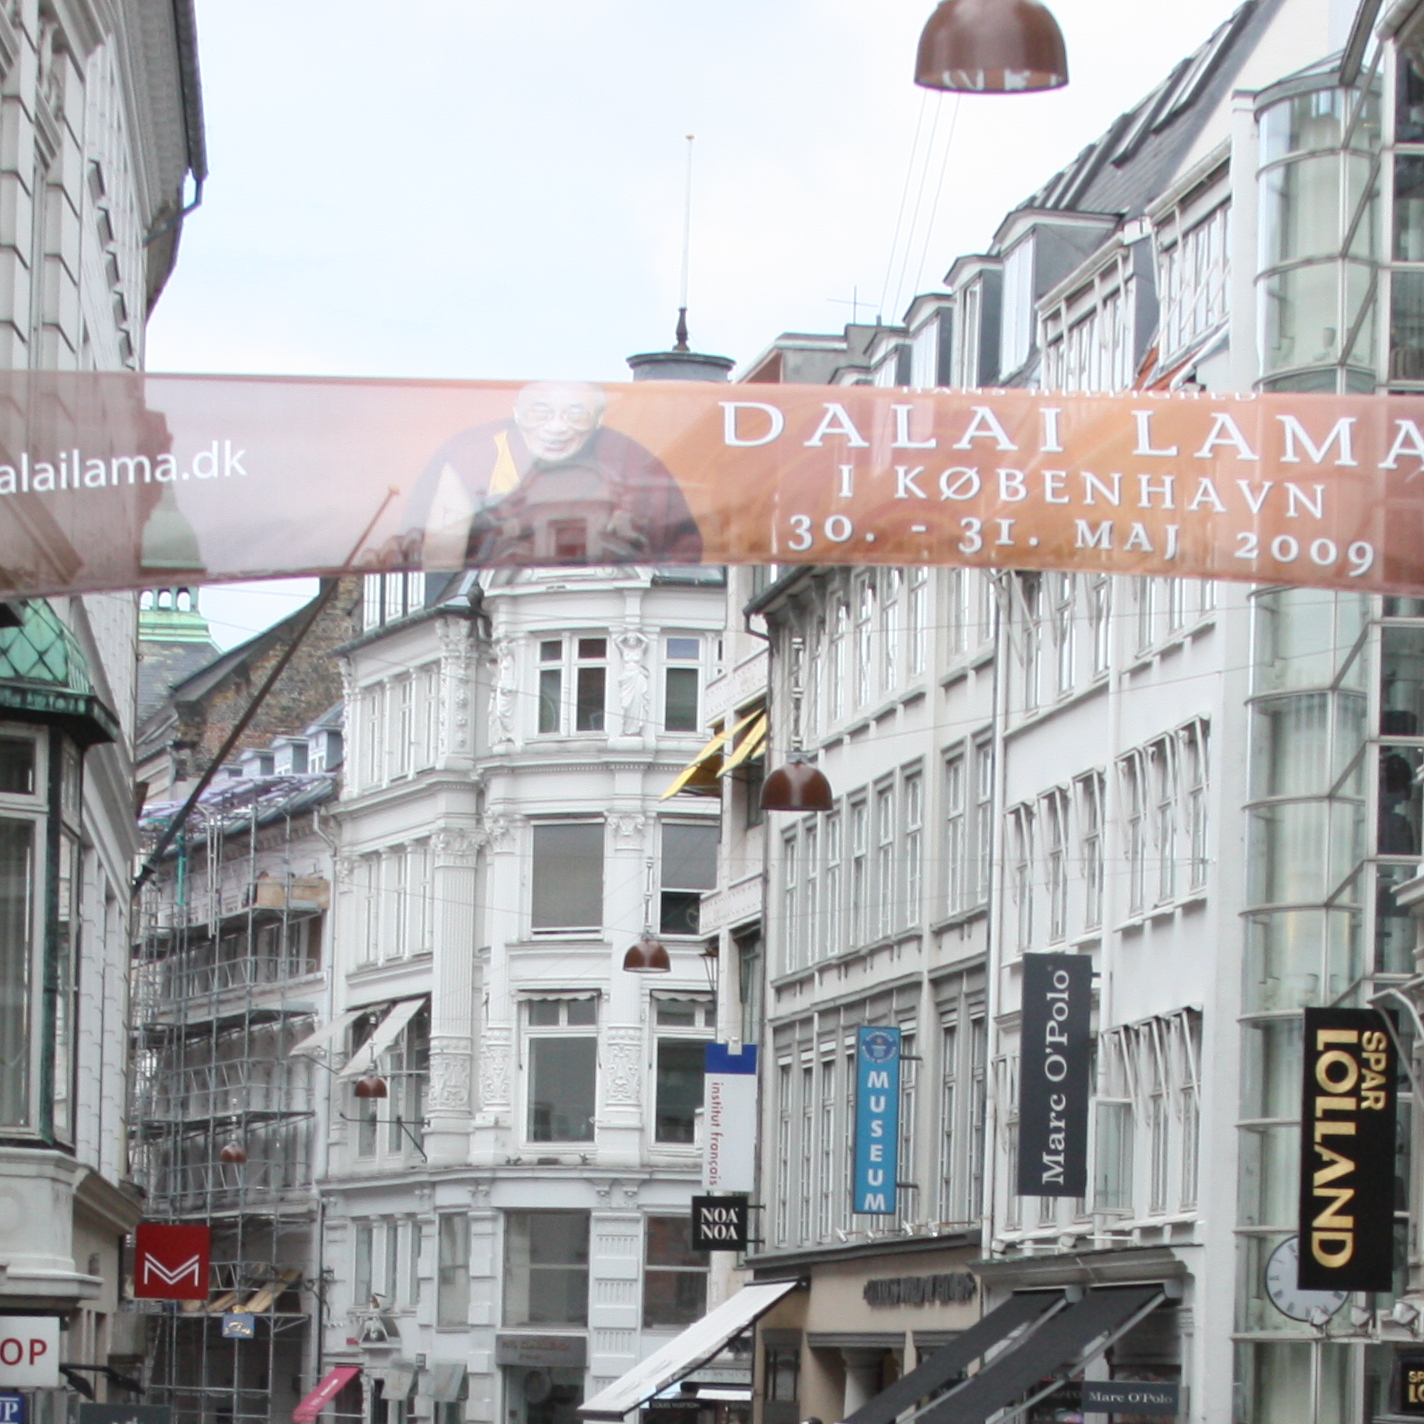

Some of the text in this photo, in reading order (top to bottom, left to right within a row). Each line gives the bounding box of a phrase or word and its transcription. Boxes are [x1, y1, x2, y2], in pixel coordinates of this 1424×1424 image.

[718, 401, 1066, 454] DALAI
[837, 463, 1327, 521] I KØBENHAVN
[787, 514, 876, 552] 30.
[958, 516, 1040, 555] 31.
[1075, 518, 1181, 561] MAJ
[1234, 531, 1375, 578] 2009
[1042, 969, 1071, 1186] Marc O'Polo
[1361, 1030, 1387, 1111] SPAR
[708, 1081, 725, 1187] institut français
[863, 1070, 890, 1212] MUSEUM
[1310, 1028, 1358, 1270] LOLLAND
[700, 1224, 739, 1240] NOA
[1089, 1390, 1125, 1402] Marc
[1128, 1391, 1174, 1404] O'Polo
